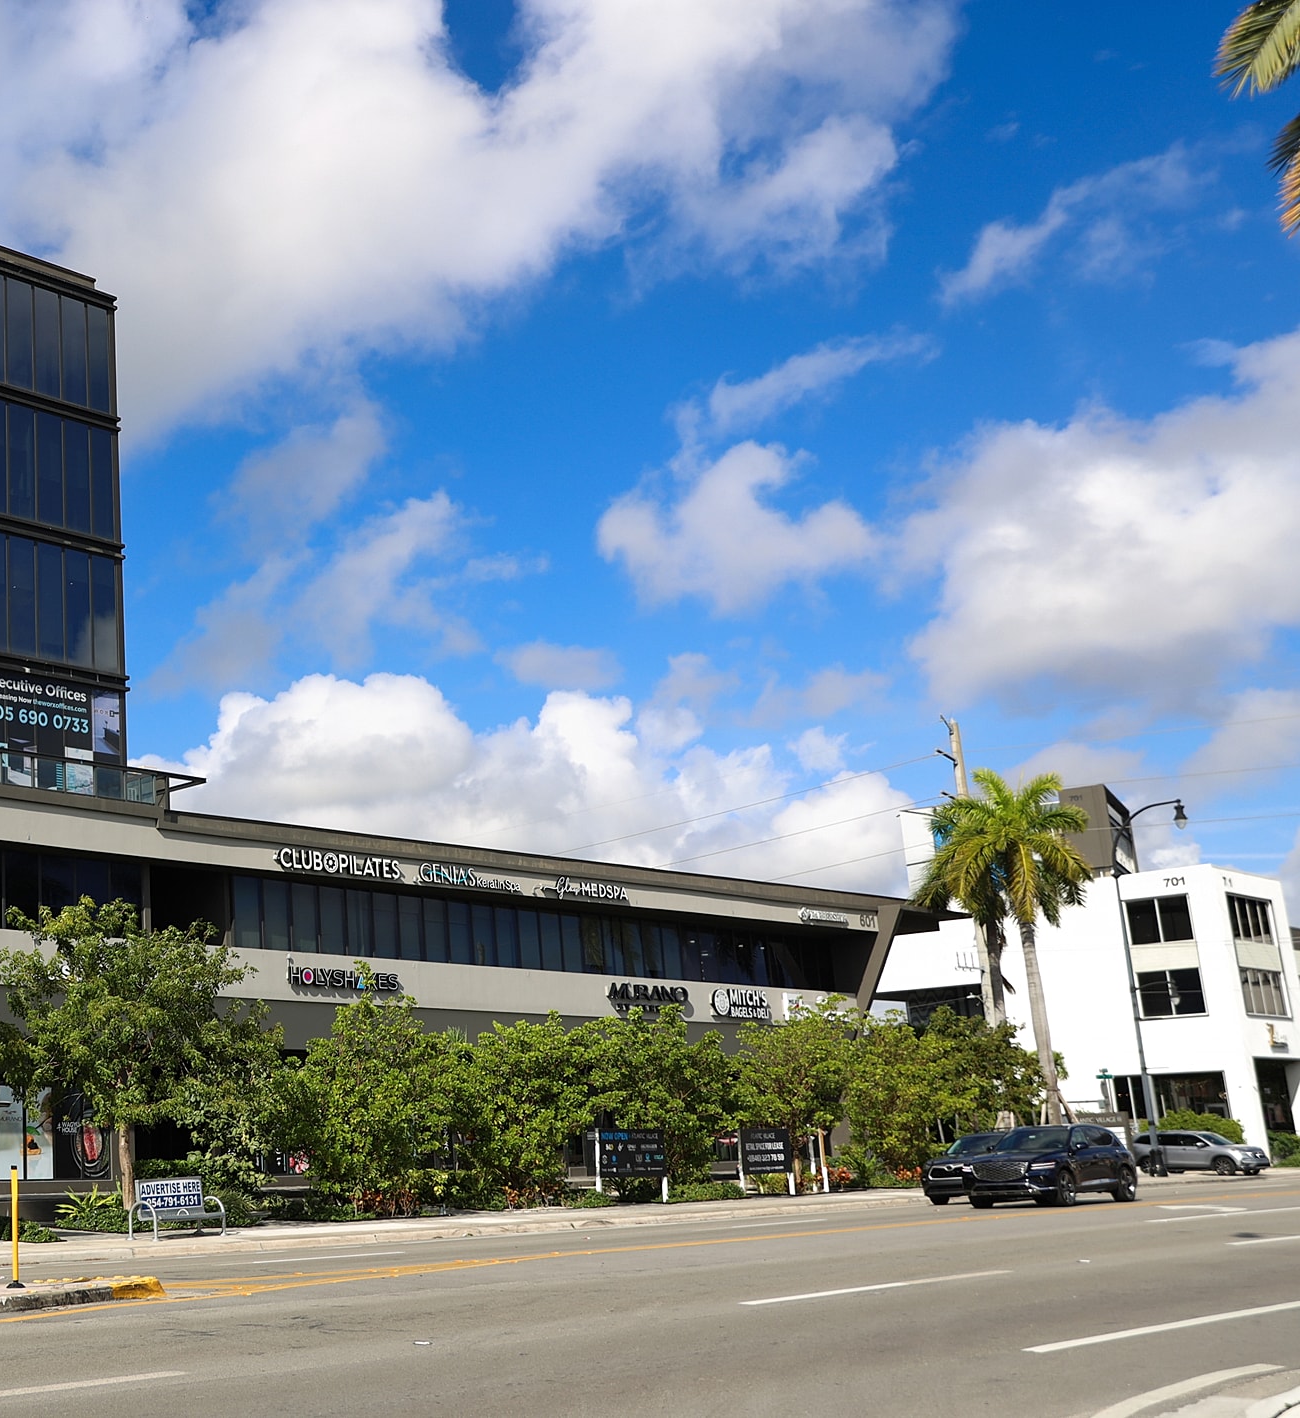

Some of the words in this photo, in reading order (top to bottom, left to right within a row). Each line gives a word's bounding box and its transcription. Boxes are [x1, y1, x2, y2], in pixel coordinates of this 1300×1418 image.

[45, 684, 87, 702] Offices
[18, 696, 32, 704] Now
[33, 698, 87, 713] theworxoffices.com
[18, 709, 48, 727] 690
[53, 714, 89, 733] 0733
[339, 854, 401, 879] PILATES
[419, 863, 476, 887] GENIAS
[581, 881, 629, 901] MEDSPA
[1163, 876, 1186, 888] 701
[859, 914, 876, 928] 601
[609, 982, 688, 1003] MURANO
[729, 988, 768, 1007] MITCH'S
[730, 1006, 753, 1018] BAGELS
[757, 1008, 770, 1019] DELI
[141, 1182, 181, 1195] ADVERTISE
[182, 1181, 201, 1192] HERE
